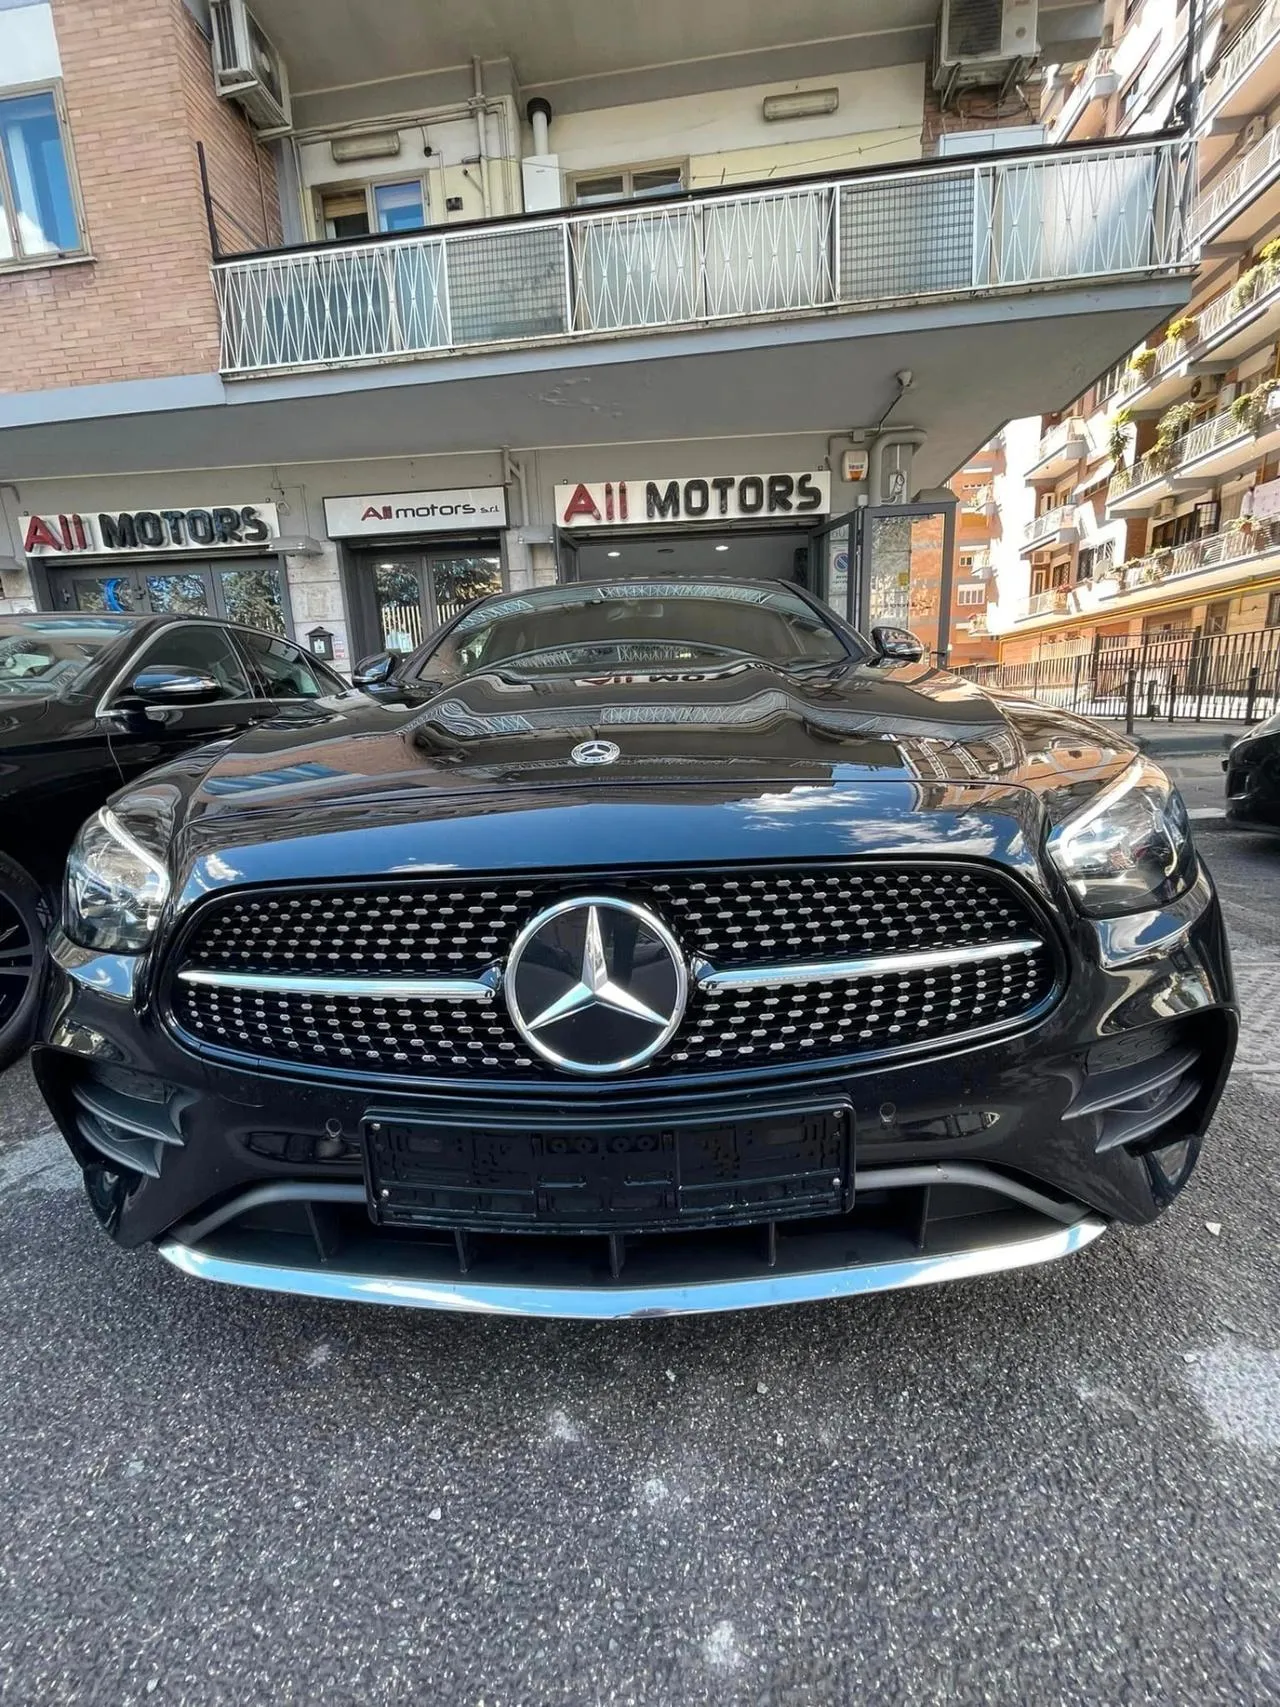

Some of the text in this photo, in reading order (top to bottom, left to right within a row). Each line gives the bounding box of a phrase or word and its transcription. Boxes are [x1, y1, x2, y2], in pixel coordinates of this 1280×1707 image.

[395, 503, 476, 519] motors
[563, 473, 822, 522] All MOTORS
[24, 506, 268, 552] All MOTORS
